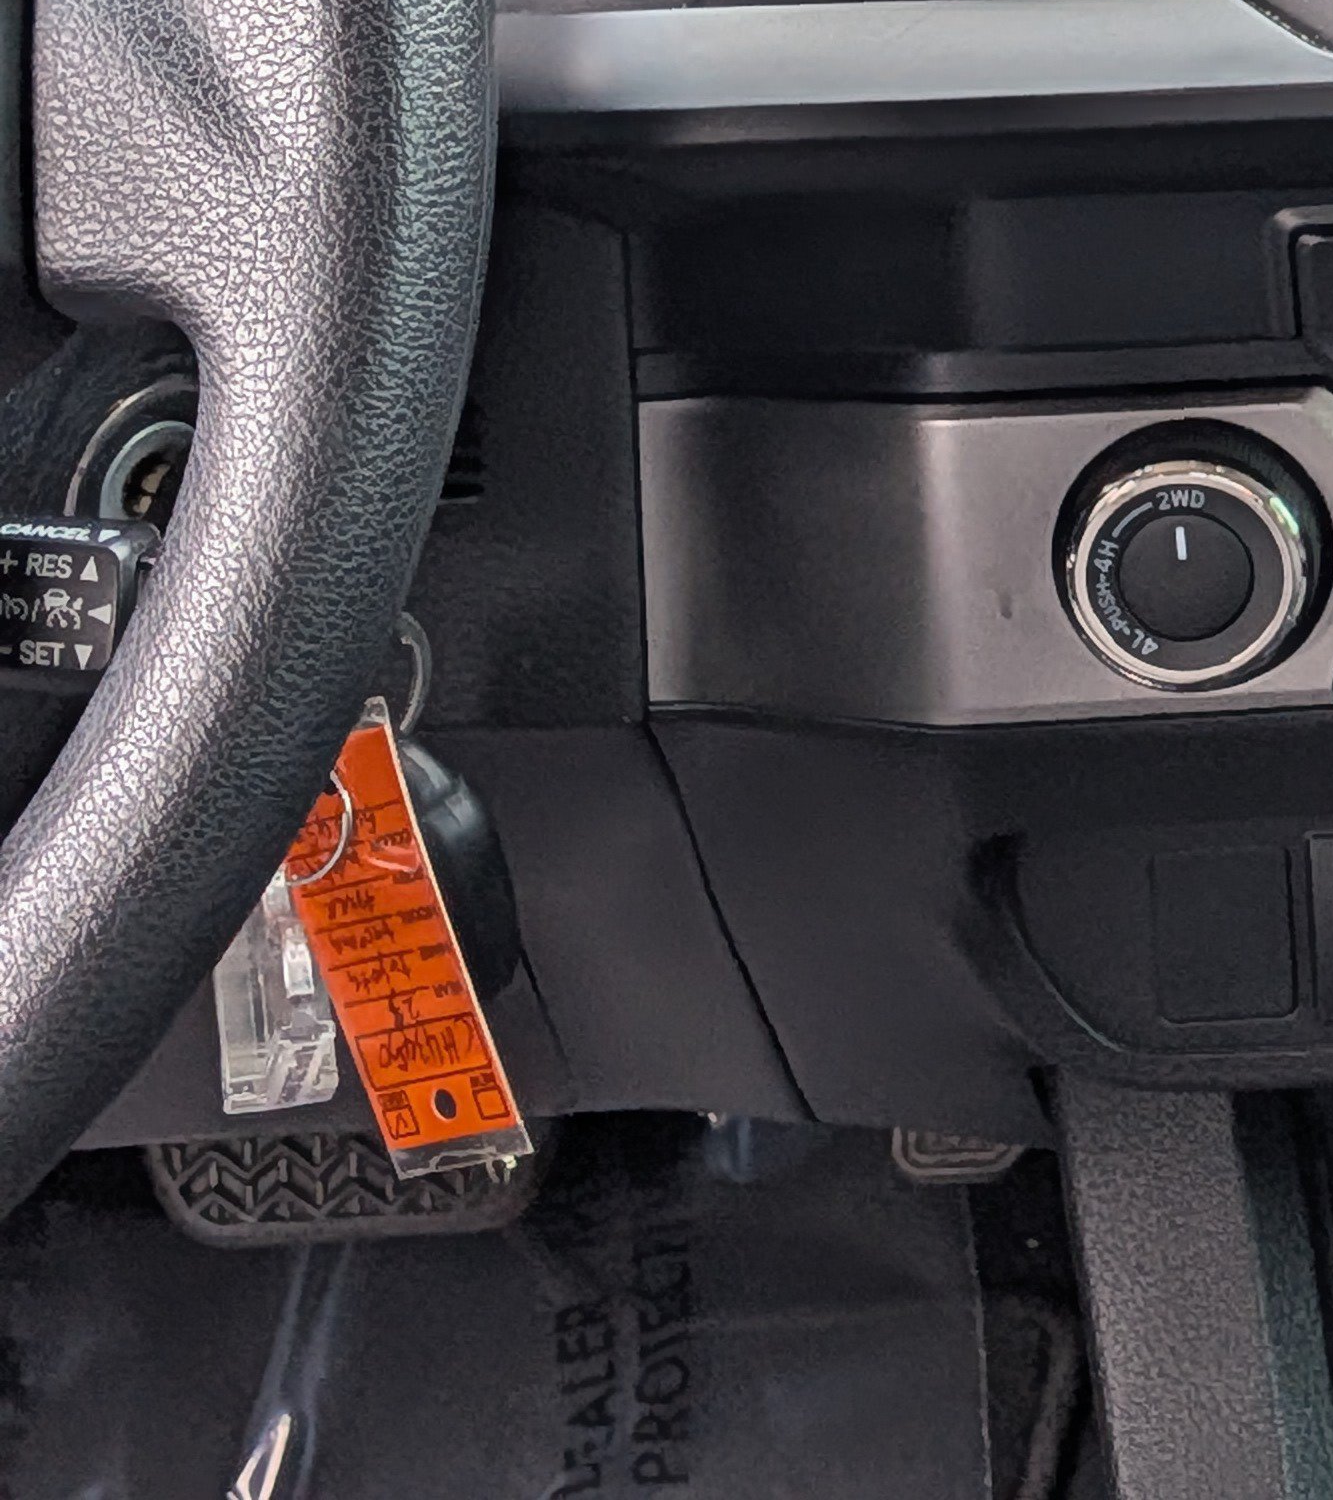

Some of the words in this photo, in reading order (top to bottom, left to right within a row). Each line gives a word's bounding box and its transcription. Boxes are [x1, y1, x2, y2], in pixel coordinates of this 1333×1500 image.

[1155, 489, 1206, 511] 2WD
[25, 552, 74, 580] RES
[19, 639, 67, 668] SET
